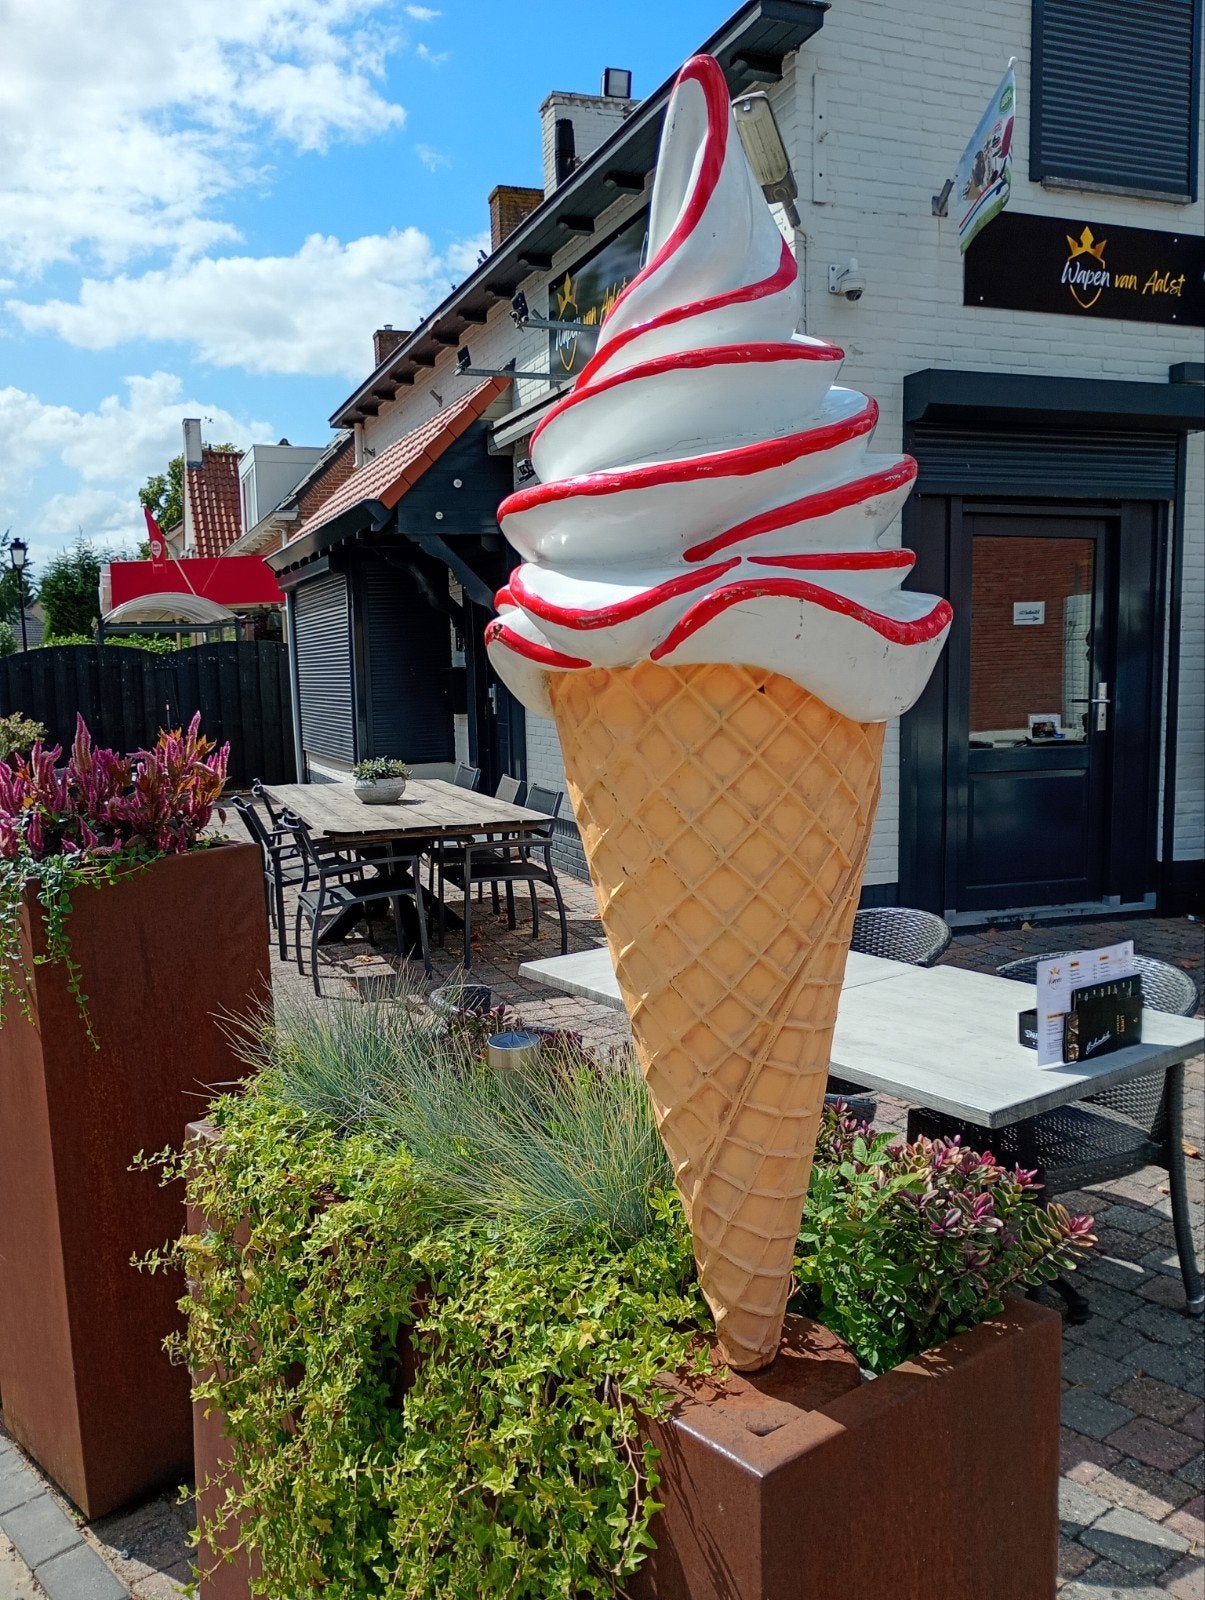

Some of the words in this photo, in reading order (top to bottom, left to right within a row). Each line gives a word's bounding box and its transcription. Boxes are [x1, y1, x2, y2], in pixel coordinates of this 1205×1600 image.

[1060, 261, 1110, 291] Wapen
[1114, 273, 1138, 291] van
[1141, 270, 1186, 297] Aalst
